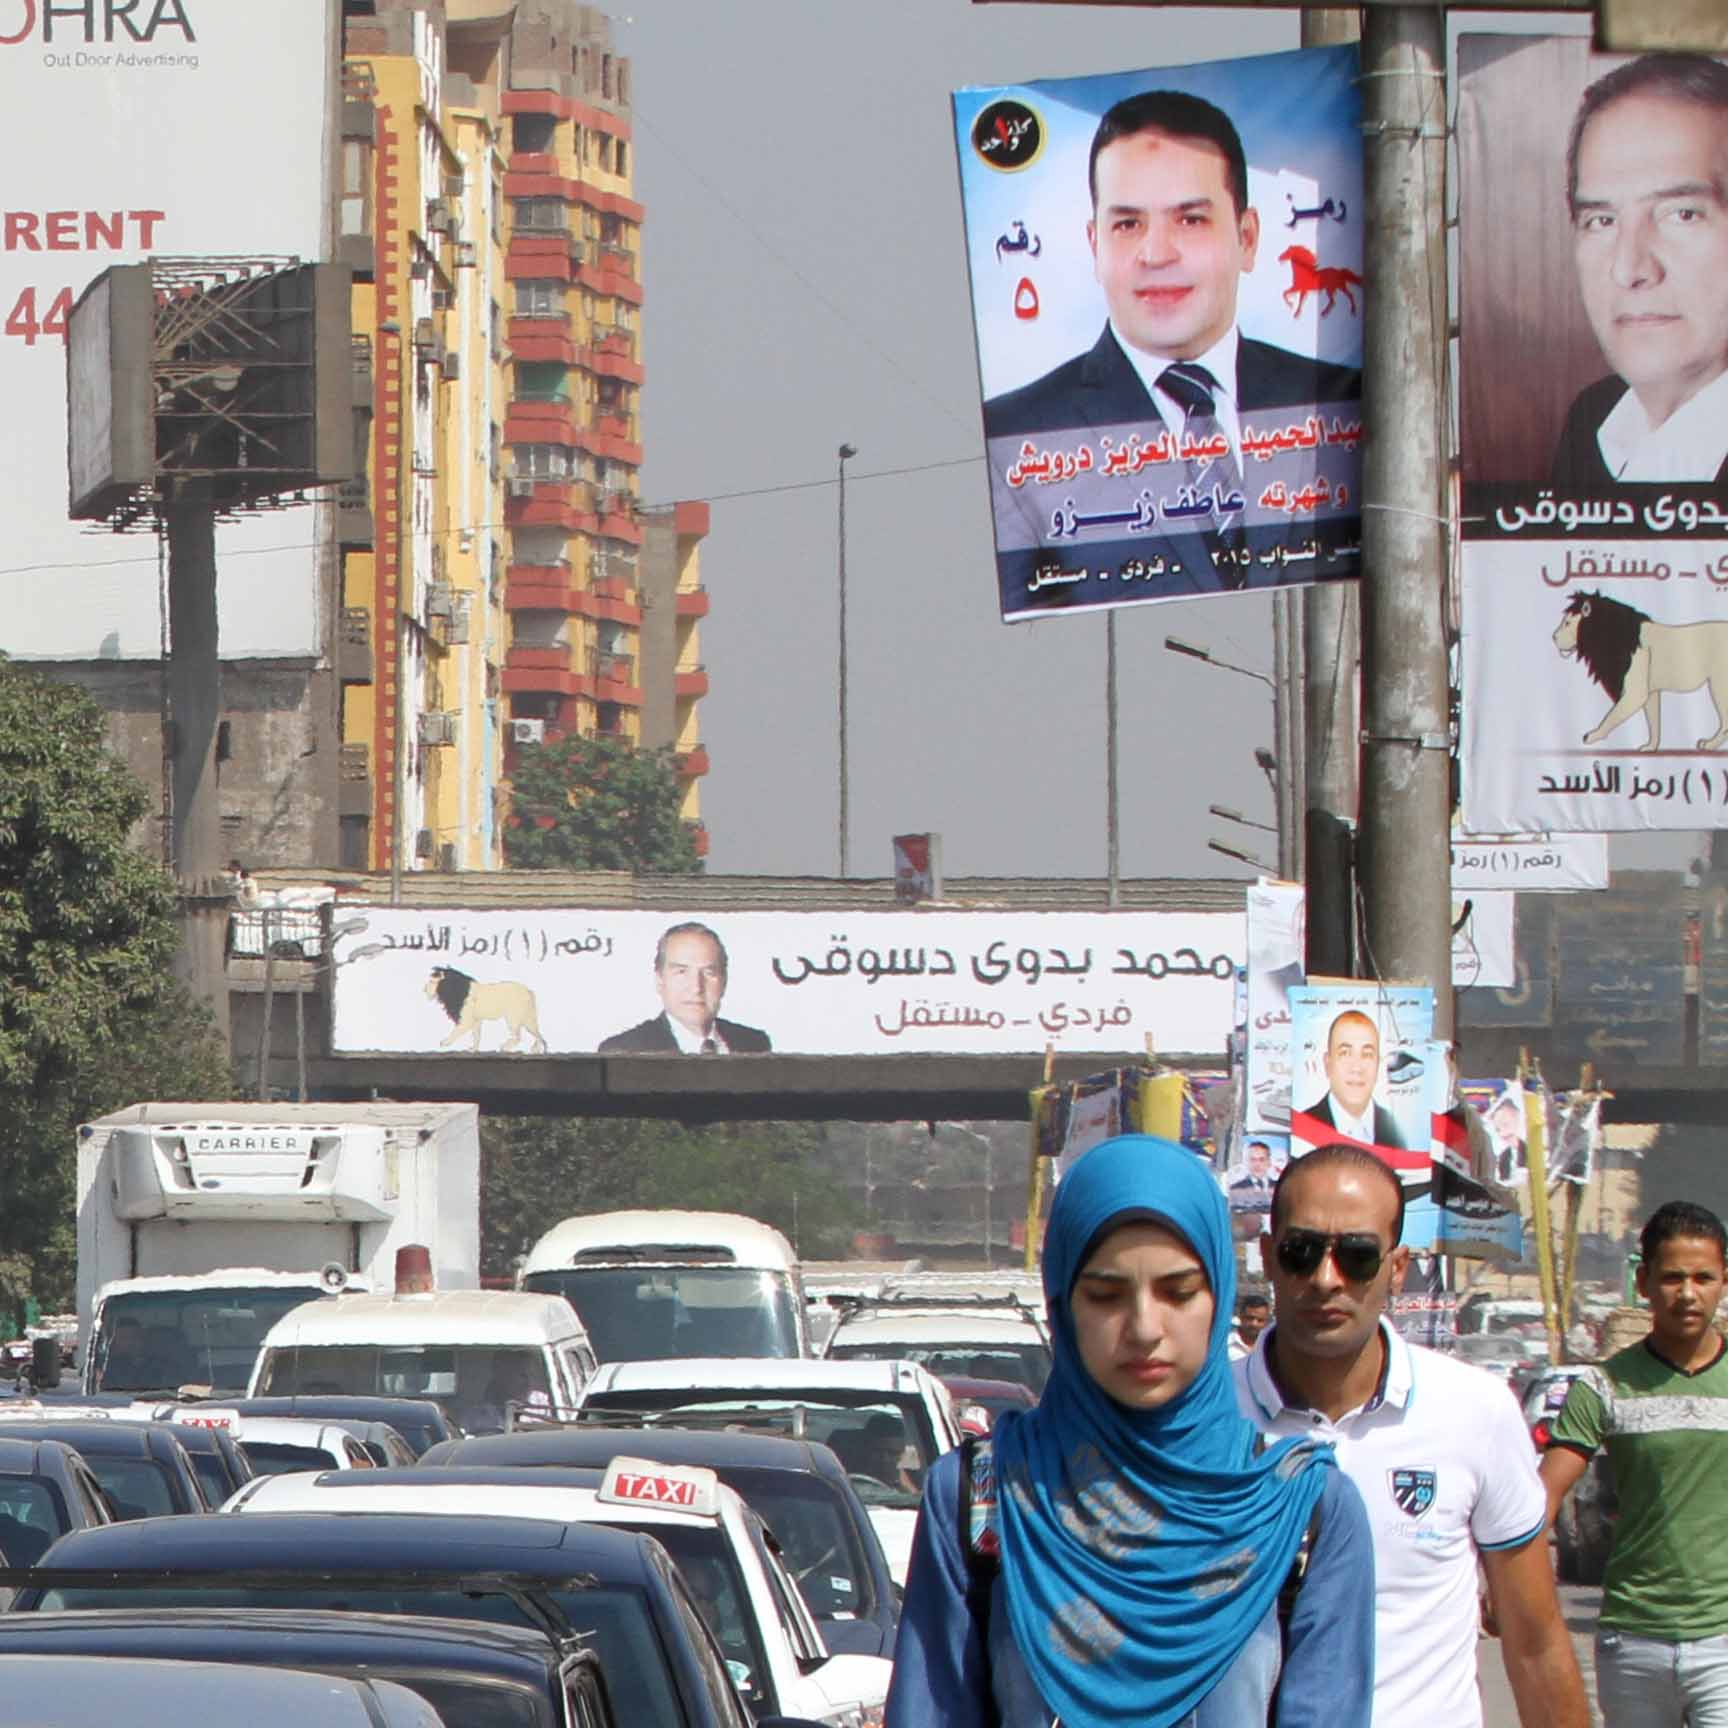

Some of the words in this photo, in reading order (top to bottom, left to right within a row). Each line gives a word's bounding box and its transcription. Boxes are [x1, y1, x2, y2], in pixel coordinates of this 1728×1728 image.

[44, 53, 71, 68] Out
[75, 52, 111, 67] Door
[115, 52, 200, 71] Advertising
[4, 210, 166, 252] RENT
[995, 221, 1042, 264] رقم
[1013, 276, 1040, 321] ٥
[1007, 440, 1091, 487] درويش
[1160, 484, 1245, 518] عاطف
[1541, 550, 1670, 588] مستقل
[1523, 849, 1561, 869] رقم
[553, 927, 613, 957] رقم
[1111, 946, 1236, 982] محمد
[875, 998, 1006, 1037] مستقل
[198, 1136, 297, 1150] CARRIER
[621, 1474, 694, 1504] TAXI
